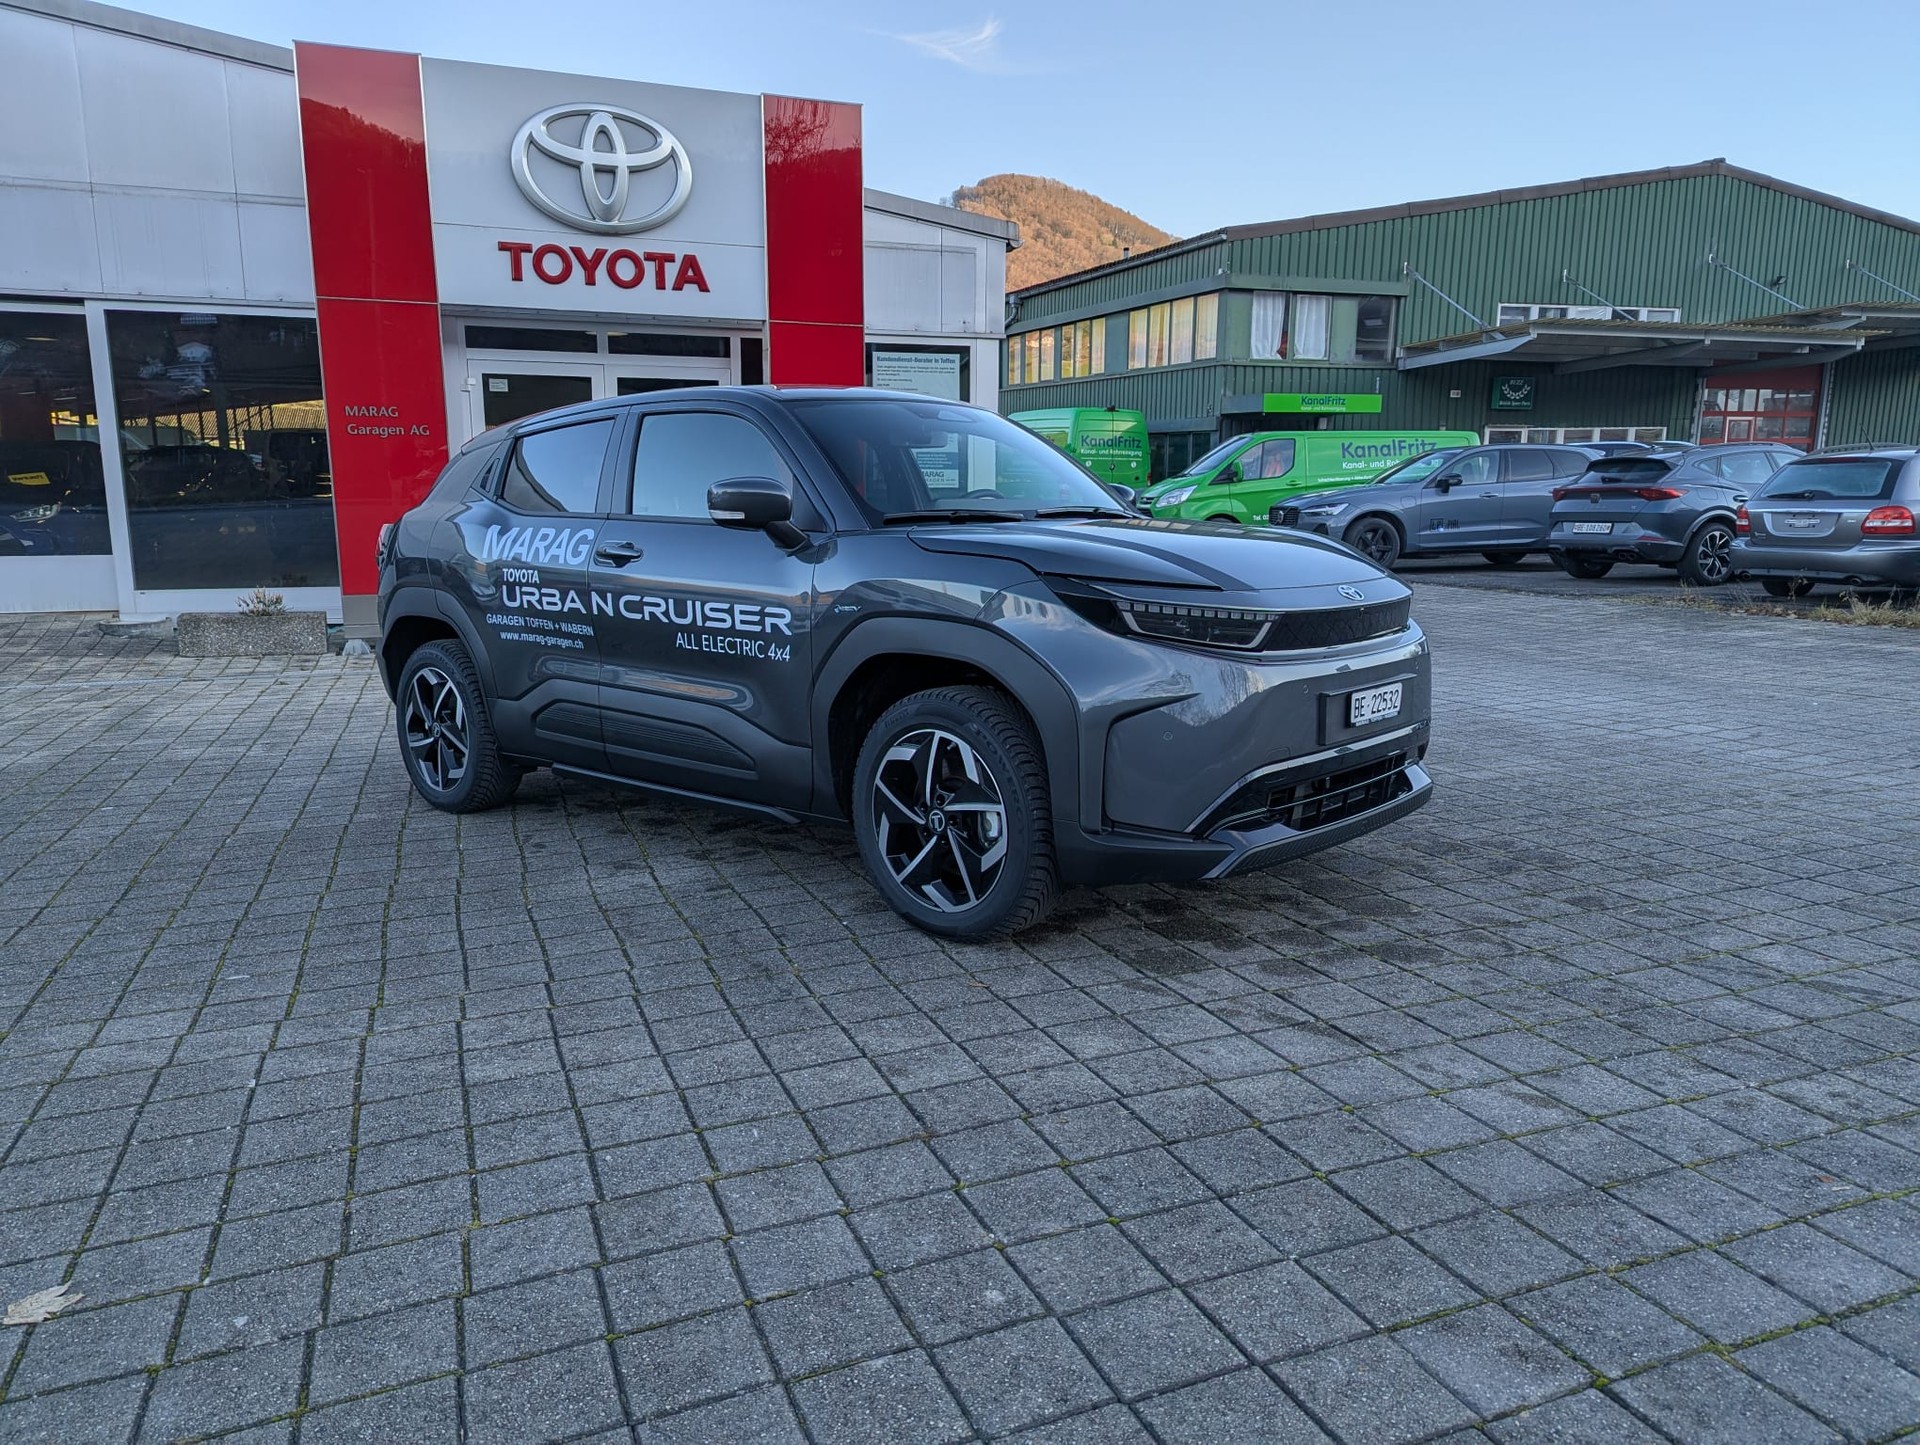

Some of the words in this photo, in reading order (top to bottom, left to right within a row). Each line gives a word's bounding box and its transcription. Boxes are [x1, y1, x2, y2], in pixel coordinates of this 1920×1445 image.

[497, 241, 711, 293] TOYOTA
[1300, 395, 1346, 406] KanalFritz
[344, 405, 399, 418] MARAG
[347, 423, 405, 439] Garagen
[410, 424, 430, 436] AG
[1081, 435, 1142, 449] KanalFritz
[1341, 438, 1437, 458] KanalFritz
[1343, 460, 1367, 469] Kanal-
[1370, 459, 1385, 468] und
[482, 524, 595, 565] MARAG
[502, 568, 540, 583] TOYOTA
[502, 585, 614, 616] URBAN
[618, 594, 793, 636] CRUISER
[486, 613, 525, 626] GARAGEN
[525, 616, 554, 630] TOFFEN
[560, 622, 594, 636] WABERN
[500, 631, 584, 649] www.marag-garagen.ch
[676, 632, 699, 651] ALL
[702, 634, 765, 658] ELECTRIC
[768, 643, 791, 662] 4x4
